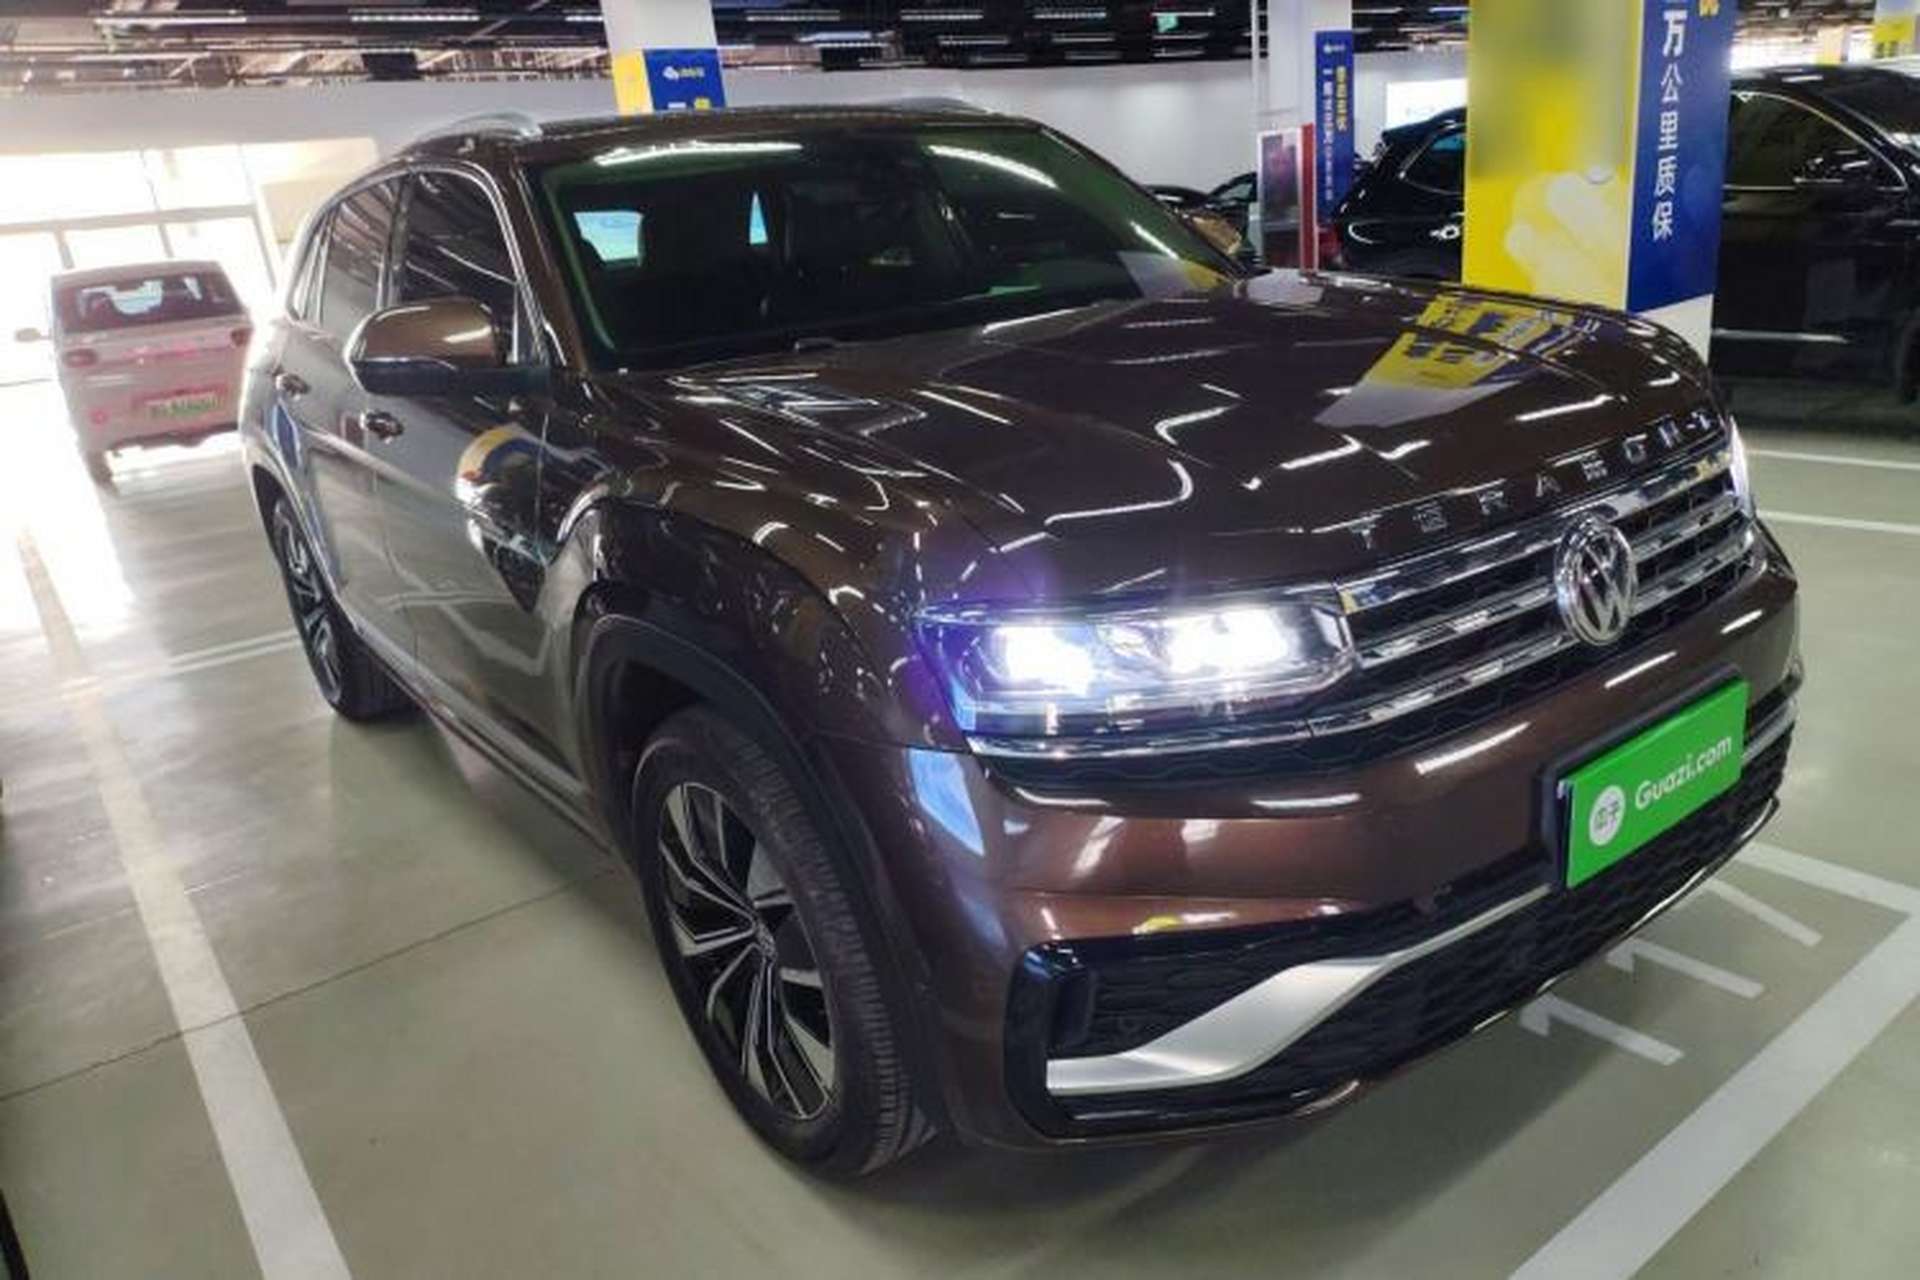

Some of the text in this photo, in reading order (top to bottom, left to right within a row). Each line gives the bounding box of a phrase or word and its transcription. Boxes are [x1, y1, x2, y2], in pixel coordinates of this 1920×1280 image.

[1653, 0, 1688, 242] 万公里质保
[1634, 735, 1733, 812] Guazi.com
